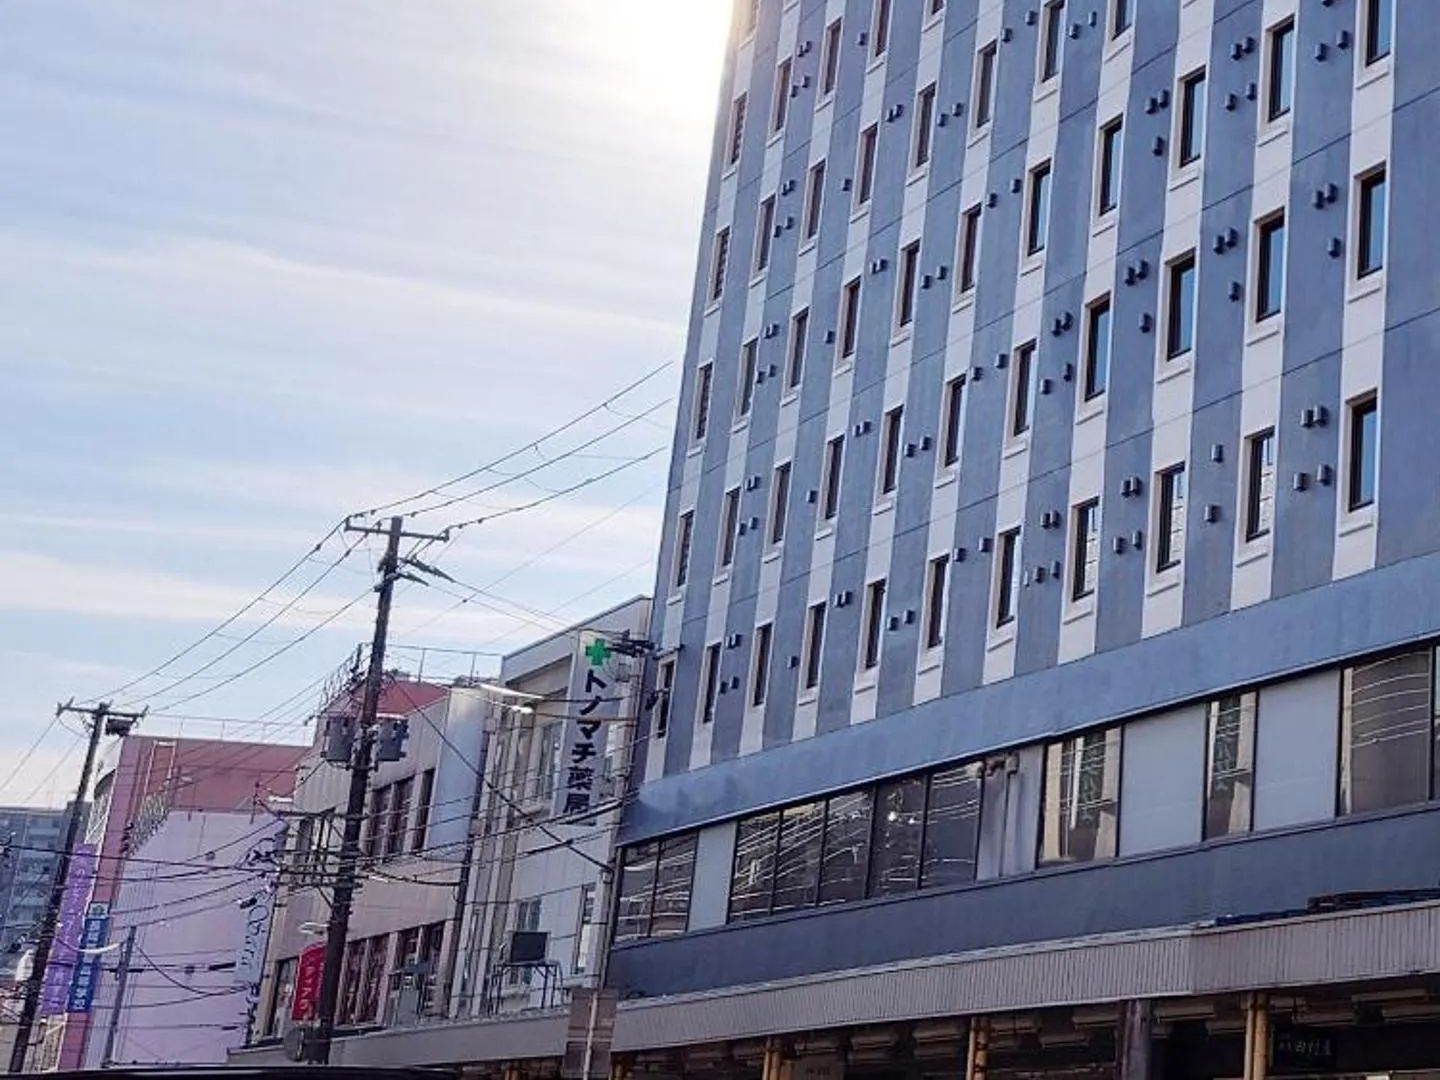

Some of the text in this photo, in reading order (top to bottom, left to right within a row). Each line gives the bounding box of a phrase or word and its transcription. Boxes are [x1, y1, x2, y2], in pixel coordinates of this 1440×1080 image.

[563, 669, 608, 814] トノマチ薬局
